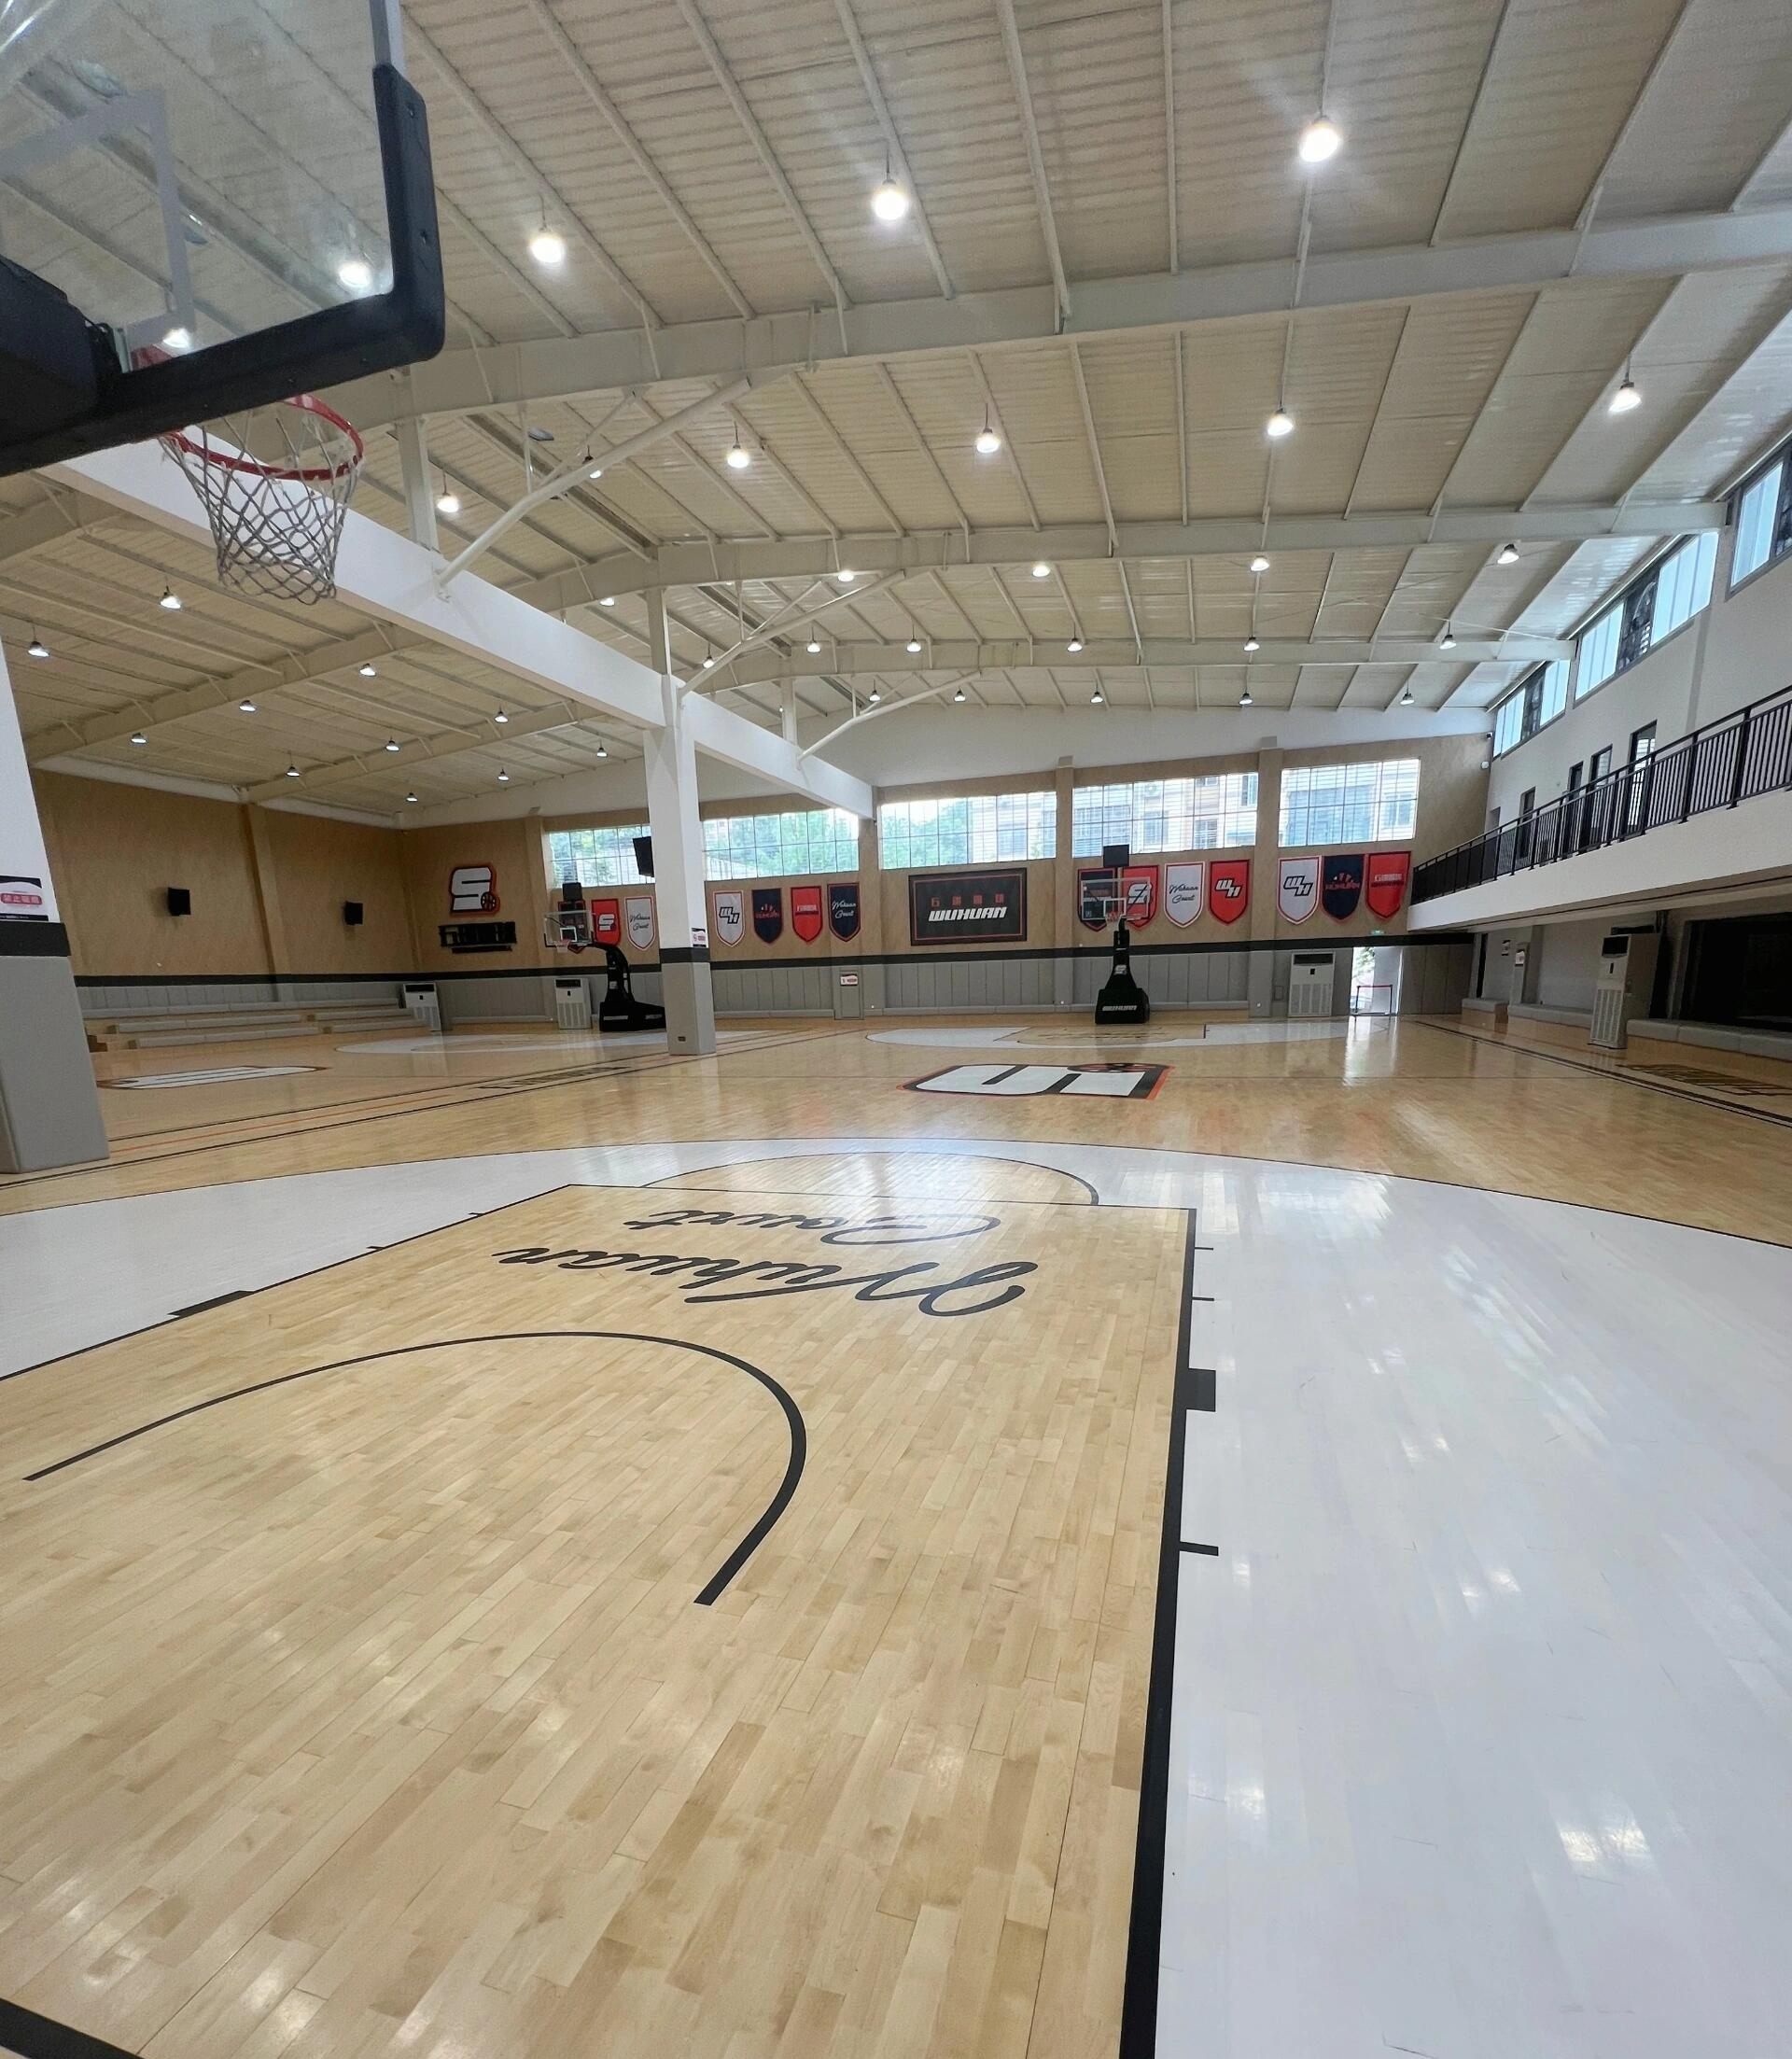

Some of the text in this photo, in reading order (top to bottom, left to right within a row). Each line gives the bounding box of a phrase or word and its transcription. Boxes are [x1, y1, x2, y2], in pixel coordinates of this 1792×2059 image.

[1215, 878, 1241, 898] WH
[928, 906, 1007, 922] WUHUAN
[623, 1210, 1001, 1246] Court
[491, 1246, 1039, 1318] Wuhuan
